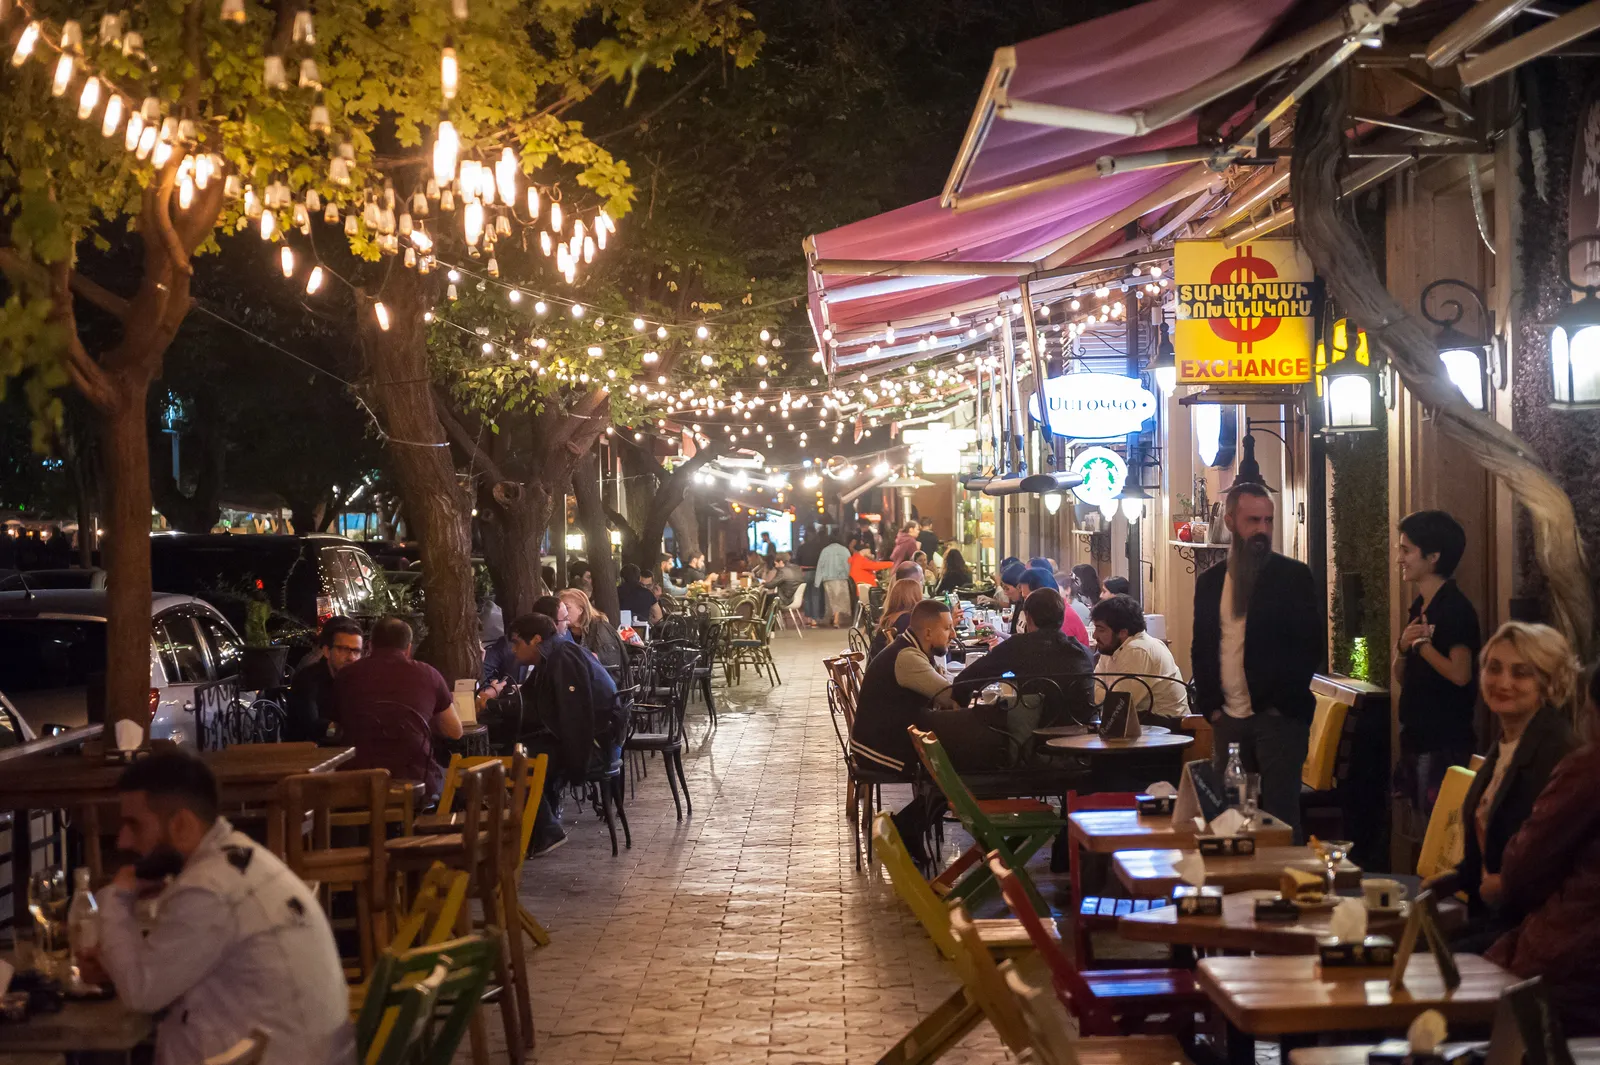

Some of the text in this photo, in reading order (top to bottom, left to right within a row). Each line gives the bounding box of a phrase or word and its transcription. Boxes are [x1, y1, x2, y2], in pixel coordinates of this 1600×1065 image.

[1180, 283, 1309, 301] ՏԱՐԱԴՐԱՄԻ
[1176, 300, 1312, 318] ՓՈԽԱՆԱԿՈՒՄ
[1181, 358, 1309, 378] EXCHANGE
